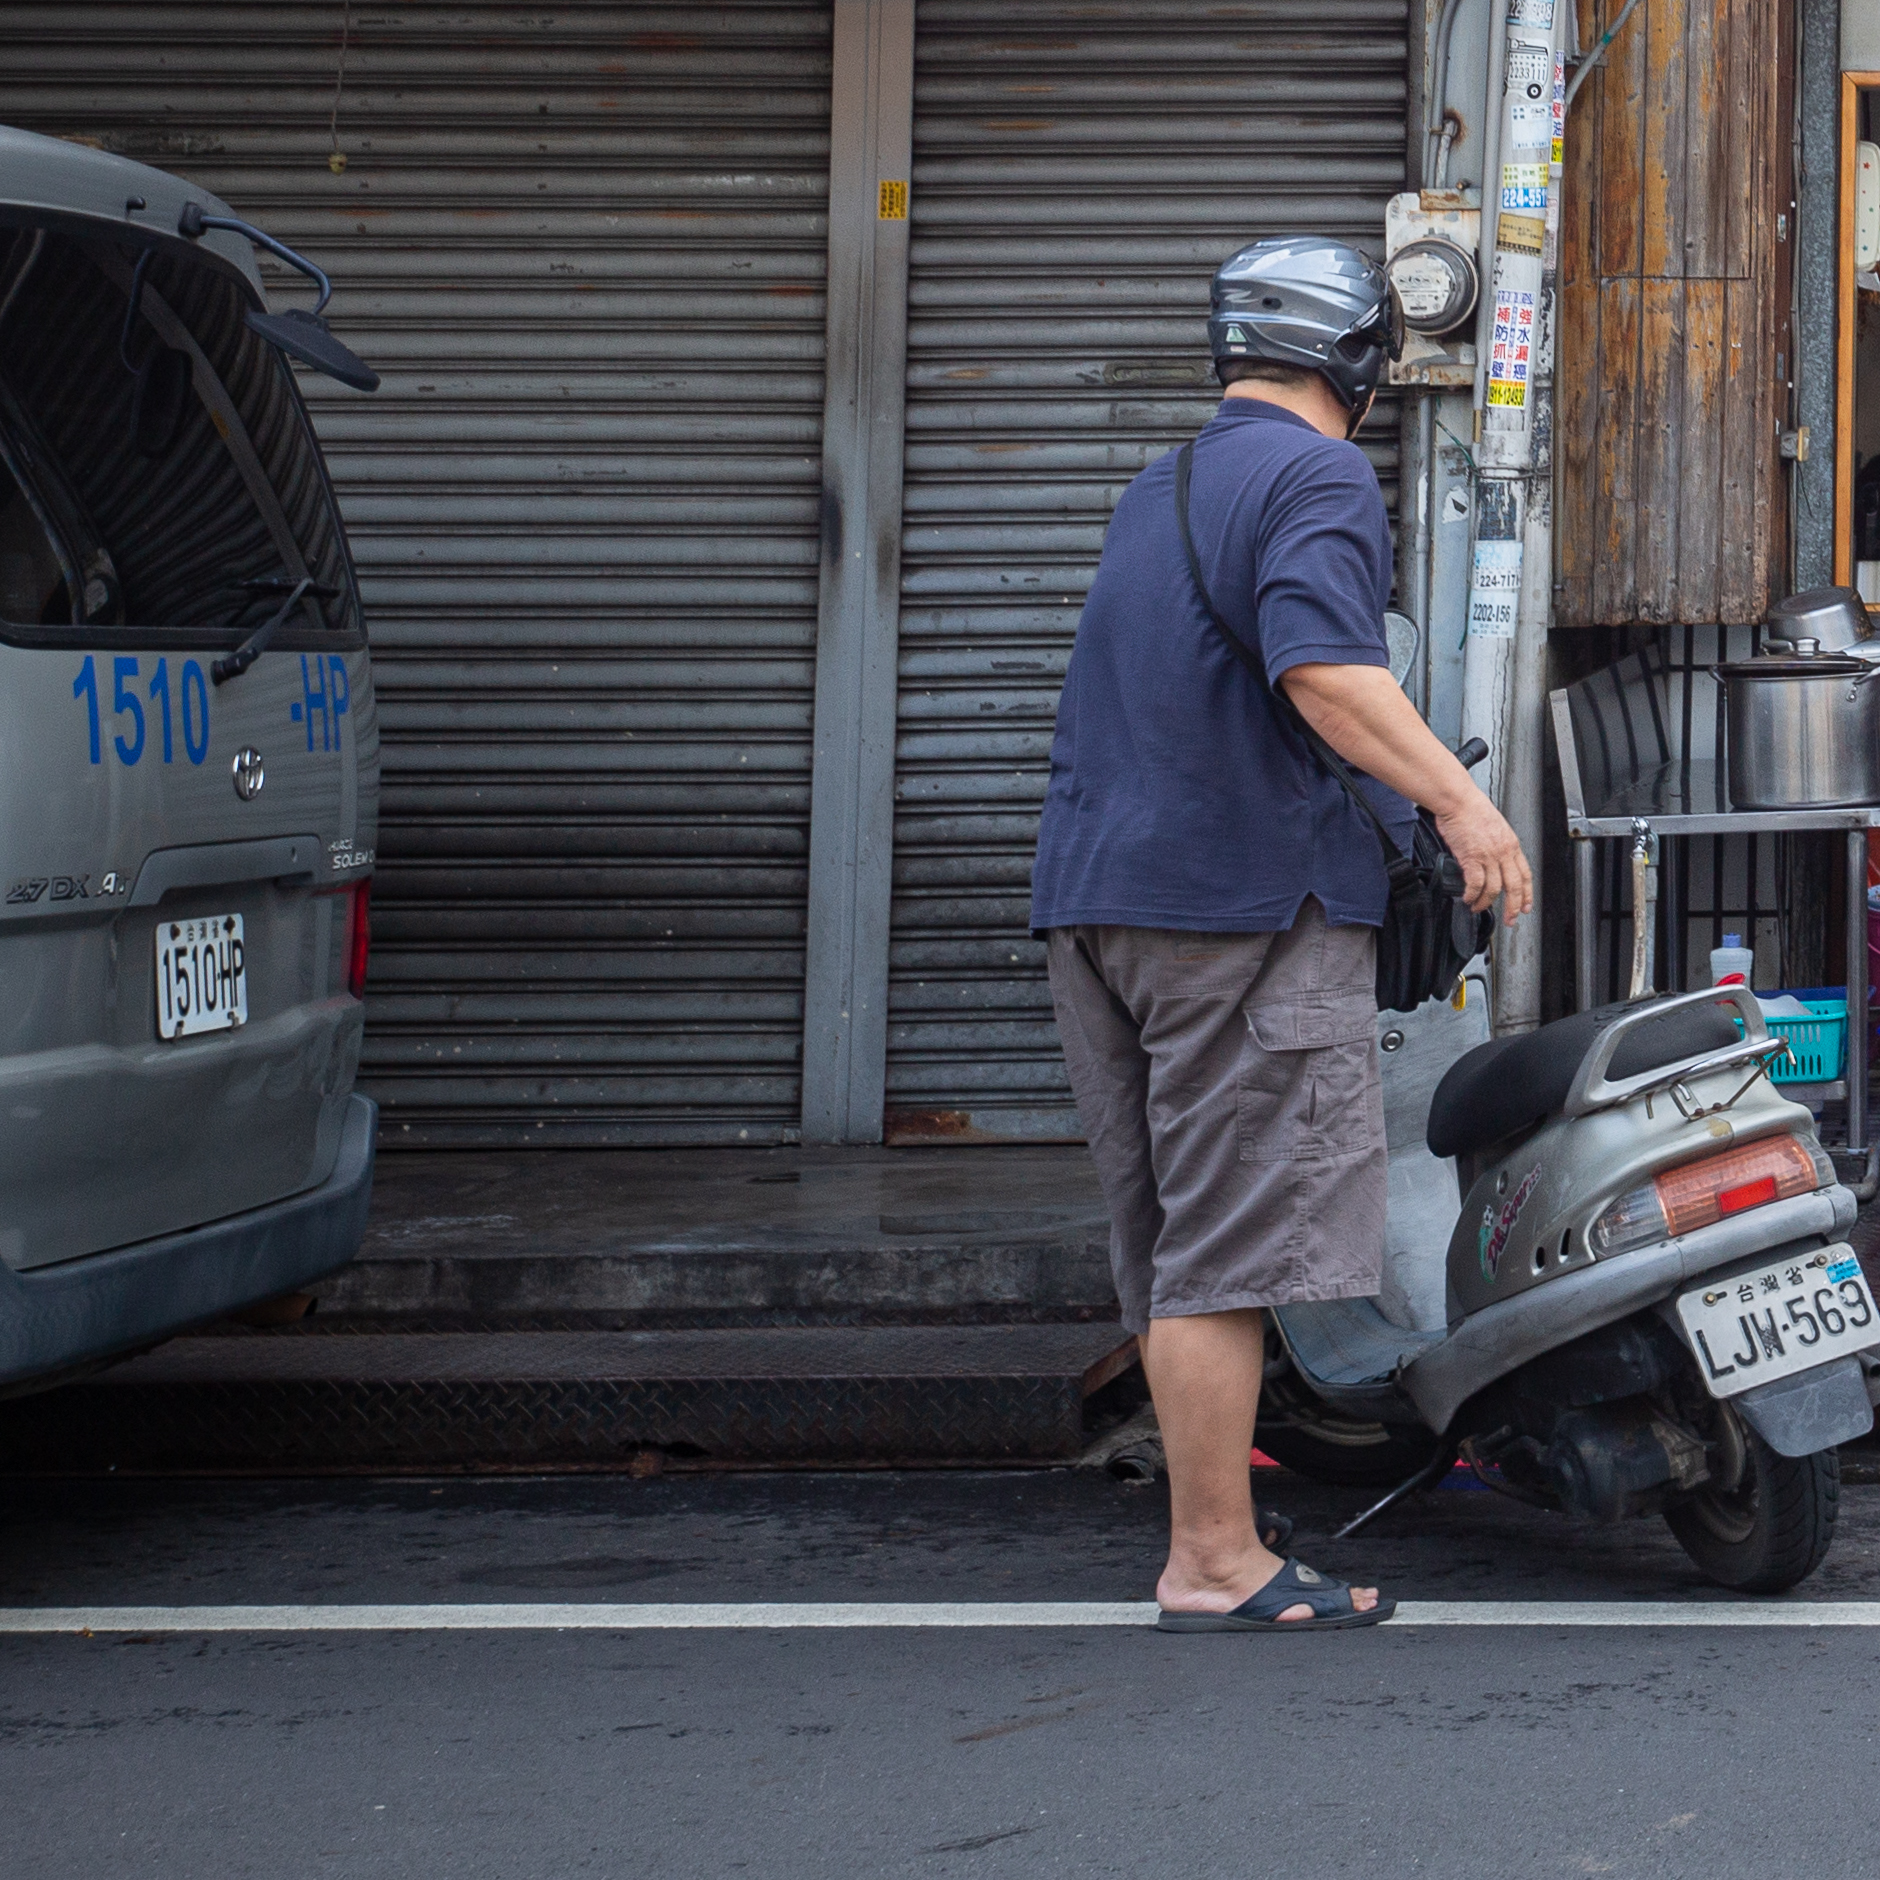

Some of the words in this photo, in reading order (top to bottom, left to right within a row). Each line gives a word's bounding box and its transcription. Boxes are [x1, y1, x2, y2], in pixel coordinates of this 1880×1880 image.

[163, 939, 244, 1020] 1510-HP
[1737, 1267, 1804, 1303] 台灣省
[1696, 1280, 1872, 1380] LJW-569
